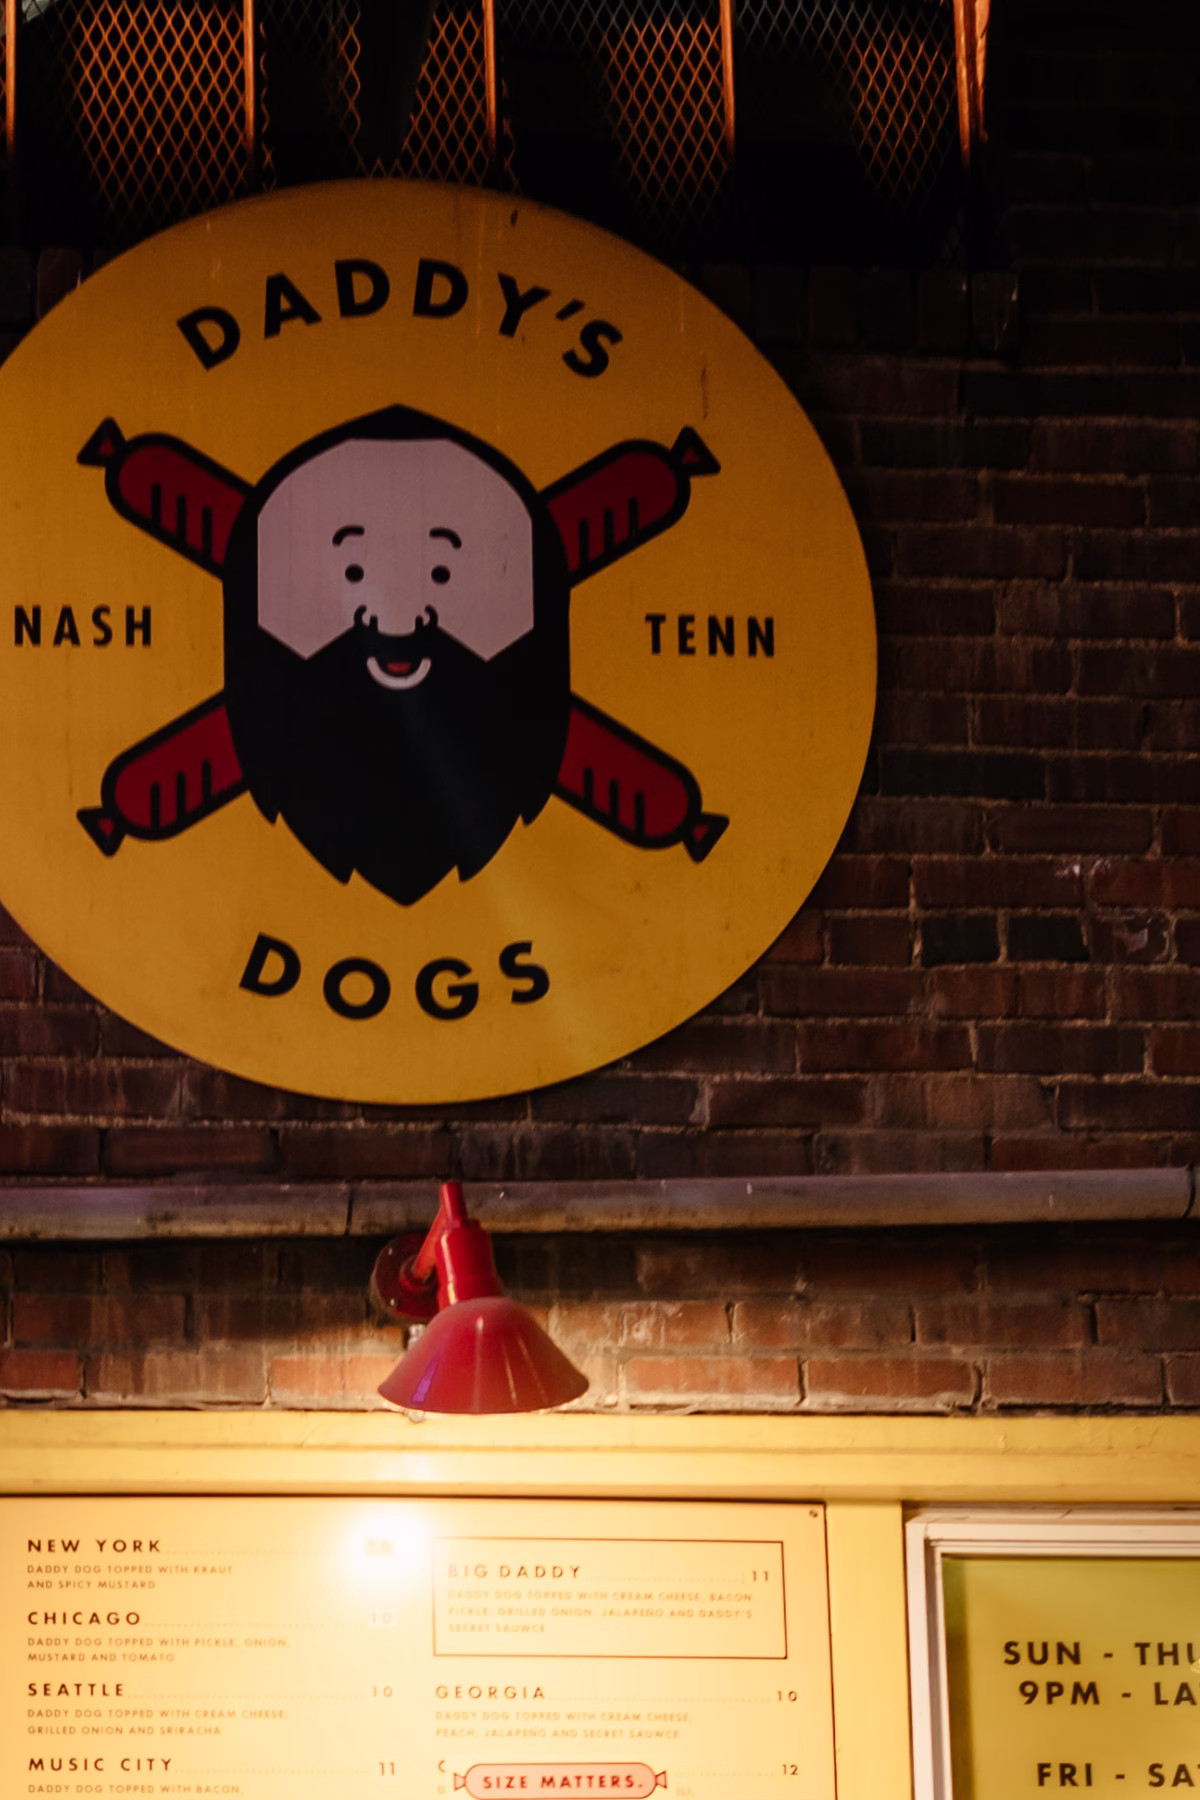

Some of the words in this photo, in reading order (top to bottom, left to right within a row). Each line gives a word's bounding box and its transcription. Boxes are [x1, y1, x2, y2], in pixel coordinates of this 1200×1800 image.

[177, 257, 623, 377] DADDY'S
[13, 604, 154, 649] NASH
[644, 611, 775, 658] TENN
[239, 932, 551, 1021] DOGS
[27, 1539, 80, 1553] NEW
[96, 1539, 160, 1553] YORK
[27, 1564, 69, 1574] DADDY
[74, 1564, 102, 1575] DOG
[107, 1565, 153, 1574] TOPPED
[158, 1565, 189, 1574] WITH
[193, 1565, 233, 1575] KRAUT
[447, 1563, 488, 1579] BIG
[499, 1565, 579, 1579] DADDY
[27, 1580, 53, 1589] AND
[58, 1579, 91, 1589] SPICY
[97, 1580, 156, 1589] MUSTARD
[27, 1611, 141, 1626] CHICAGO
[27, 1653, 85, 1662] MUSTARD
[91, 1653, 117, 1662] AND
[122, 1653, 175, 1662] TOMATO
[1003, 1641, 1081, 1665] SUN
[27, 1683, 123, 1697] SEATTLE
[435, 1685, 545, 1699] GEORGIA
[1018, 1680, 1100, 1706] 9PM
[1154, 1681, 1200, 1706] LA
[27, 1725, 77, 1735] GRILLED
[81, 1726, 123, 1735] ONION
[129, 1725, 155, 1735] AND
[159, 1726, 221, 1735] SRIRACHA
[28, 1757, 104, 1772] MUSIC
[120, 1757, 171, 1772] CITY
[483, 1775, 527, 1789] SIZE
[540, 1775, 643, 1789] MATTERS.
[1037, 1763, 1093, 1787] FRI
[1148, 1763, 1200, 1788] SA
[27, 1784, 70, 1794] DADDY
[75, 1784, 103, 1794] DOG
[109, 1784, 155, 1794] TOPPED
[159, 1784, 191, 1793] WITH
